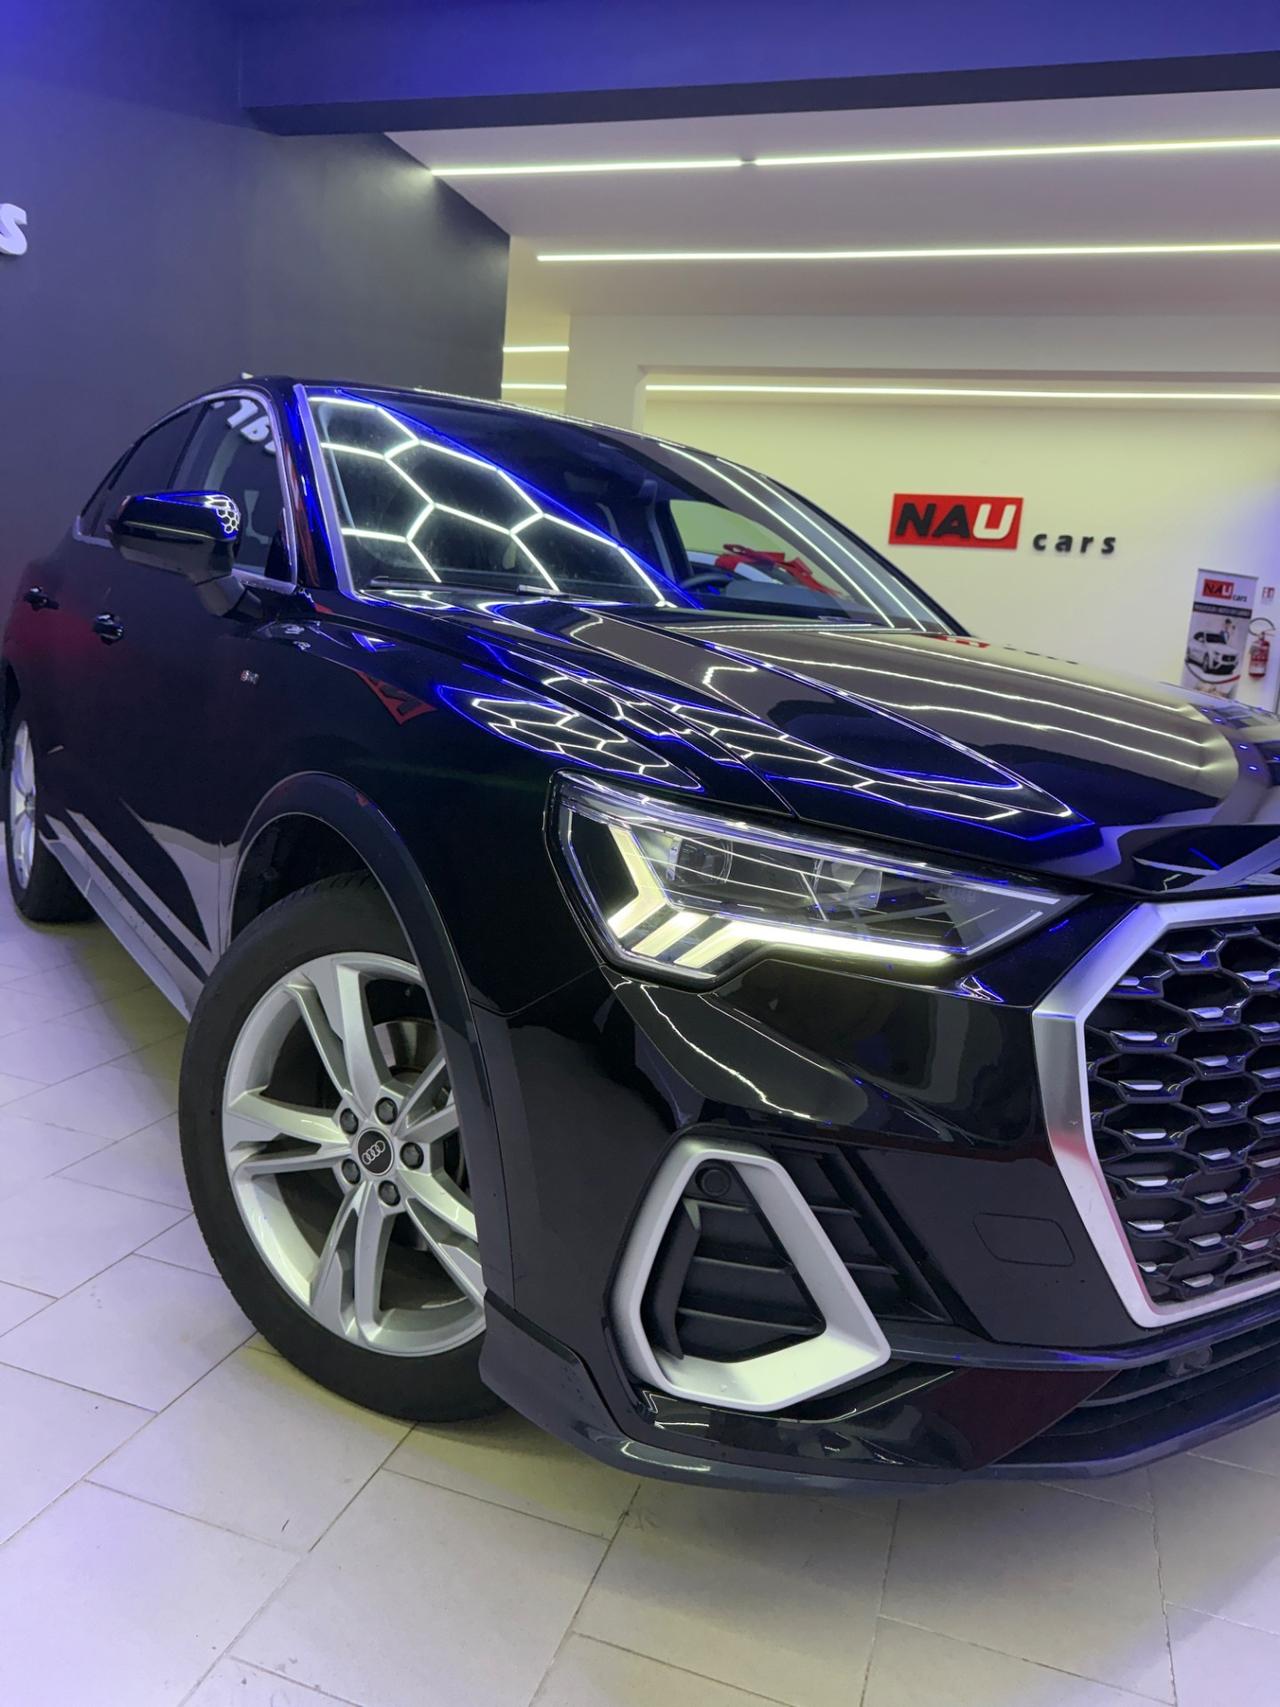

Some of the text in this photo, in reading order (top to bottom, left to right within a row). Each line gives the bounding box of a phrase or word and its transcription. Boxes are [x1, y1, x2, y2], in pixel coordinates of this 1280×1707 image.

[895, 502, 1116, 555] NAU cars
[1205, 581, 1232, 597] NAU
